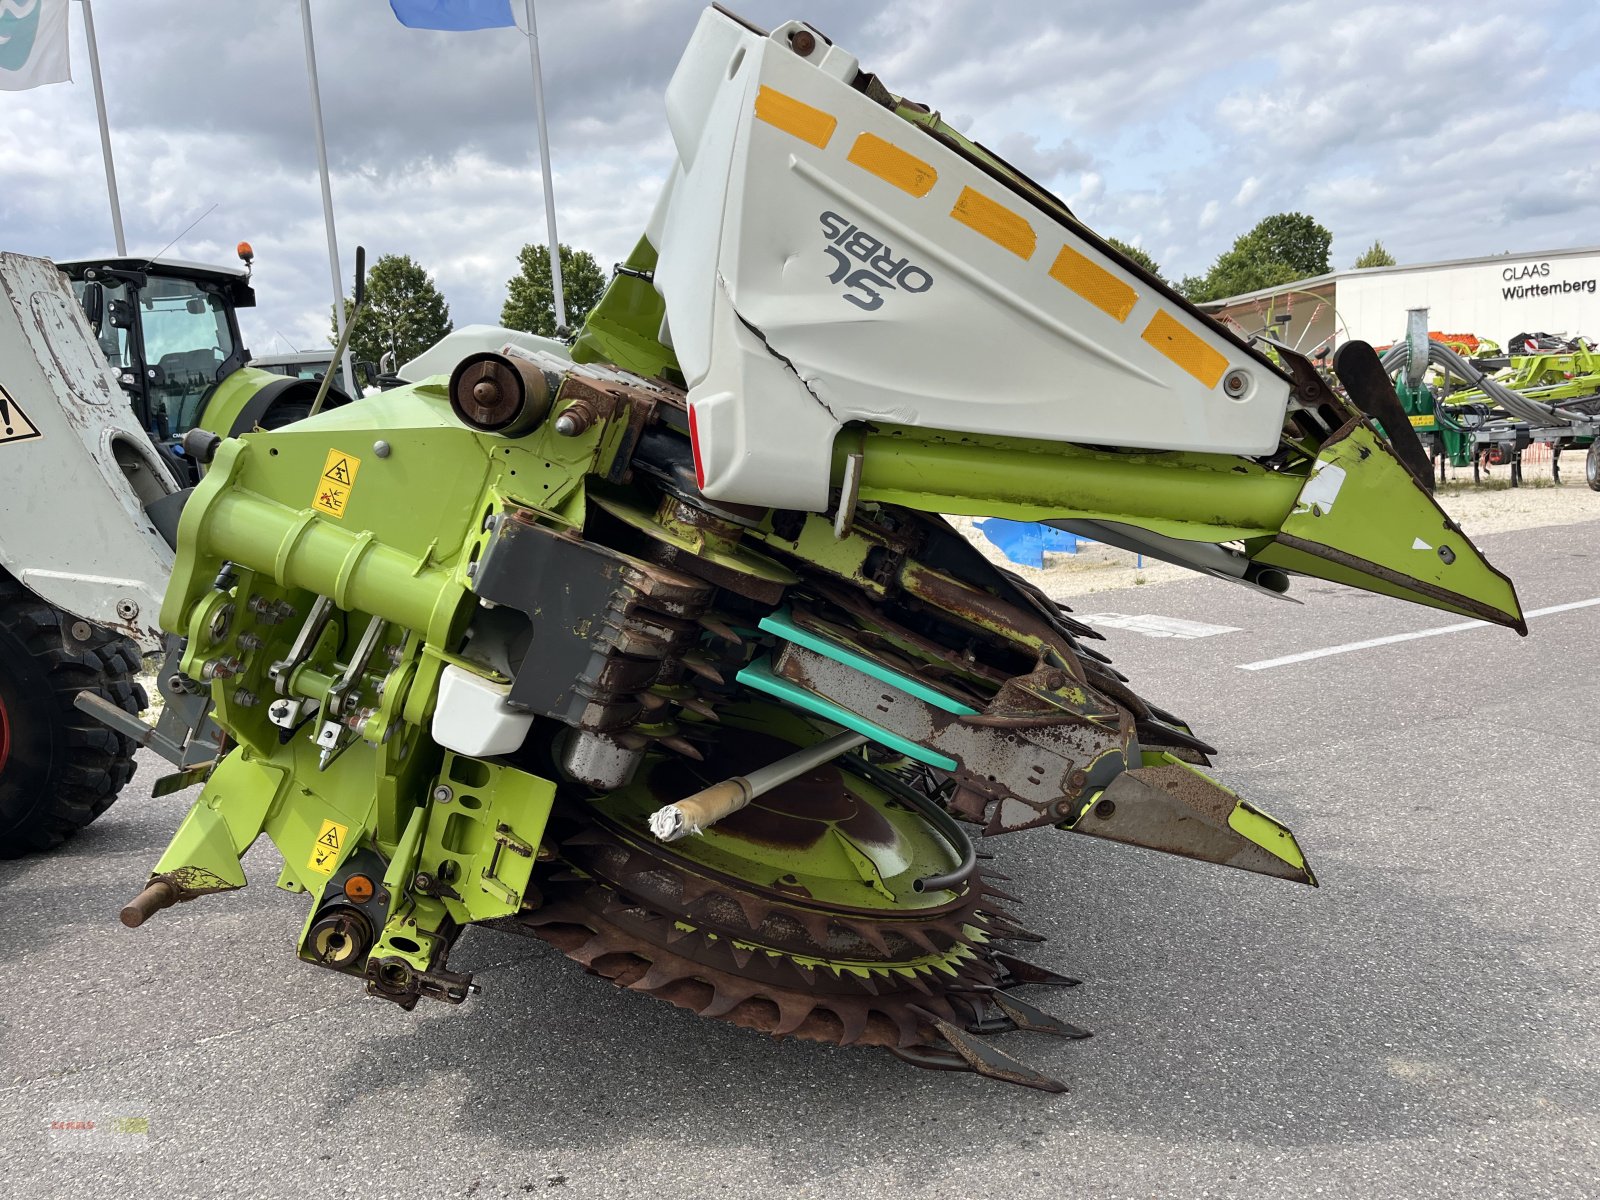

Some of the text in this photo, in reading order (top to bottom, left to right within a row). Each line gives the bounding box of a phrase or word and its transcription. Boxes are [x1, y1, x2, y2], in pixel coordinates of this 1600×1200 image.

[819, 211, 934, 293] ORBIS
[1502, 262, 1550, 281] CLAAS
[1502, 279, 1597, 300] Württemberg
